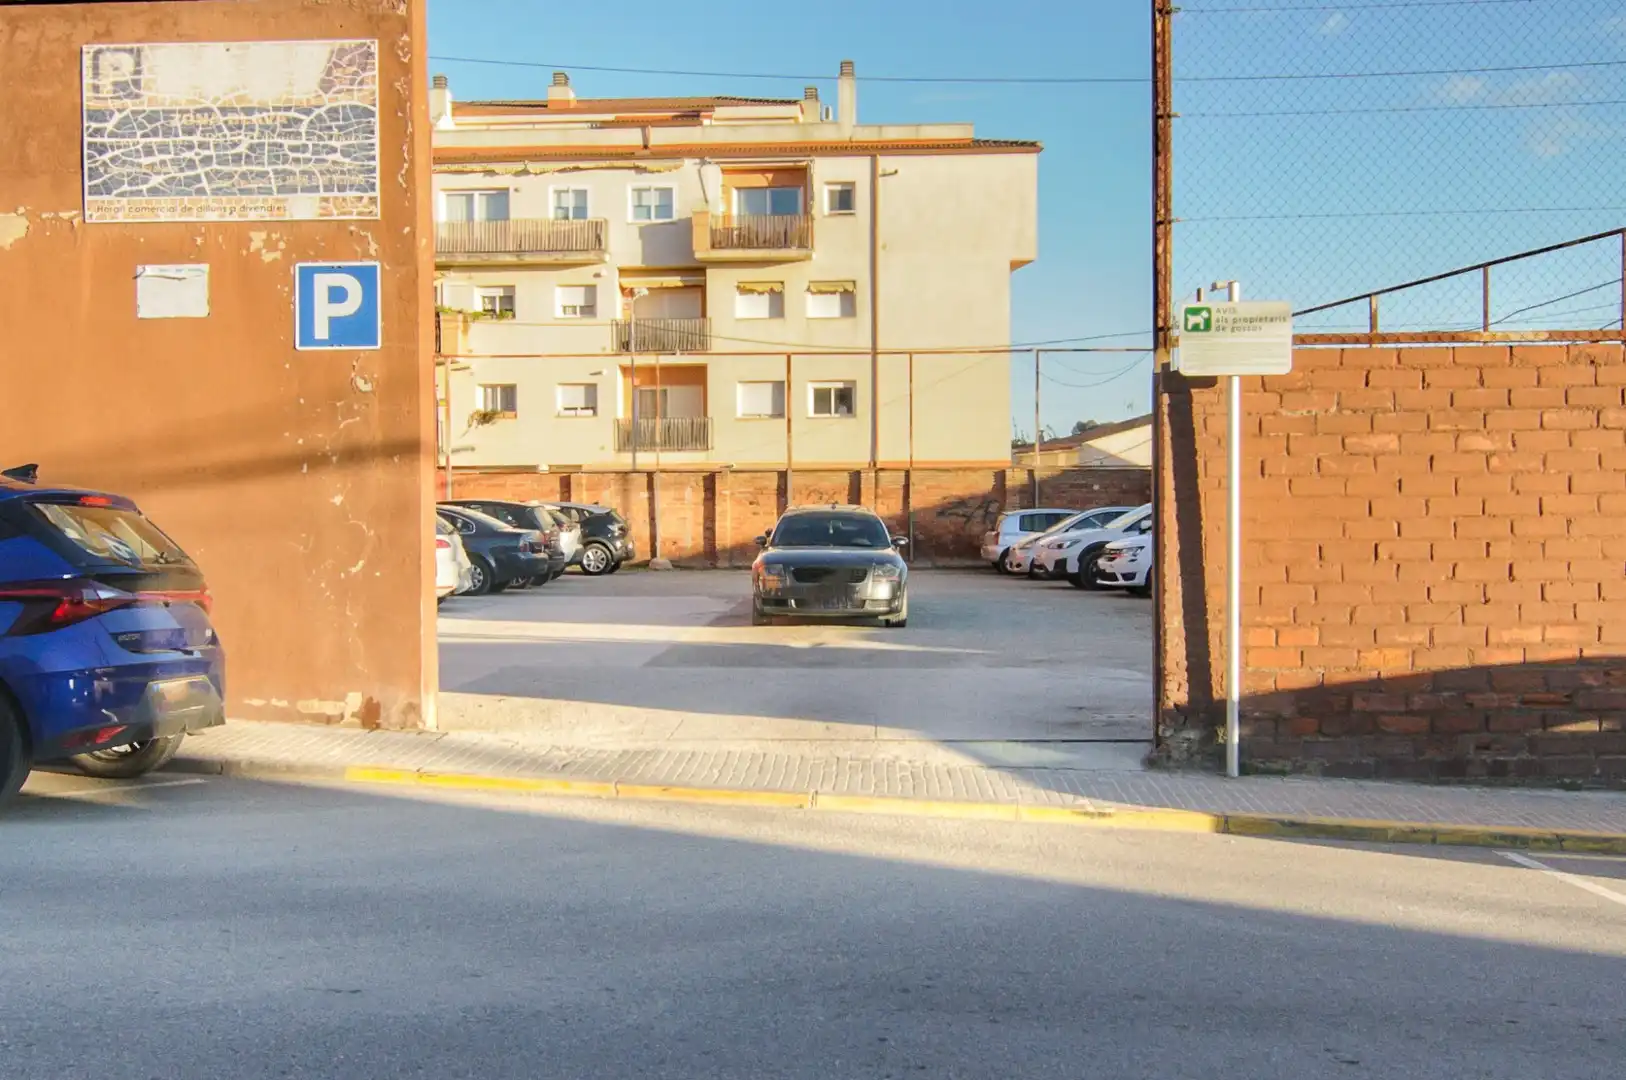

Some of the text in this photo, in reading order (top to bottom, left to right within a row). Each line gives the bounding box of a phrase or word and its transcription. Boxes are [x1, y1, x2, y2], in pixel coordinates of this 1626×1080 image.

[128, 204, 177, 214] comercial
[180, 203, 193, 213] de
[196, 203, 229, 213] dilluns
[239, 203, 287, 213] divendres
[313, 273, 363, 340] P
[1215, 315, 1287, 325] als propietaris
[1230, 326, 1263, 334] gossos
